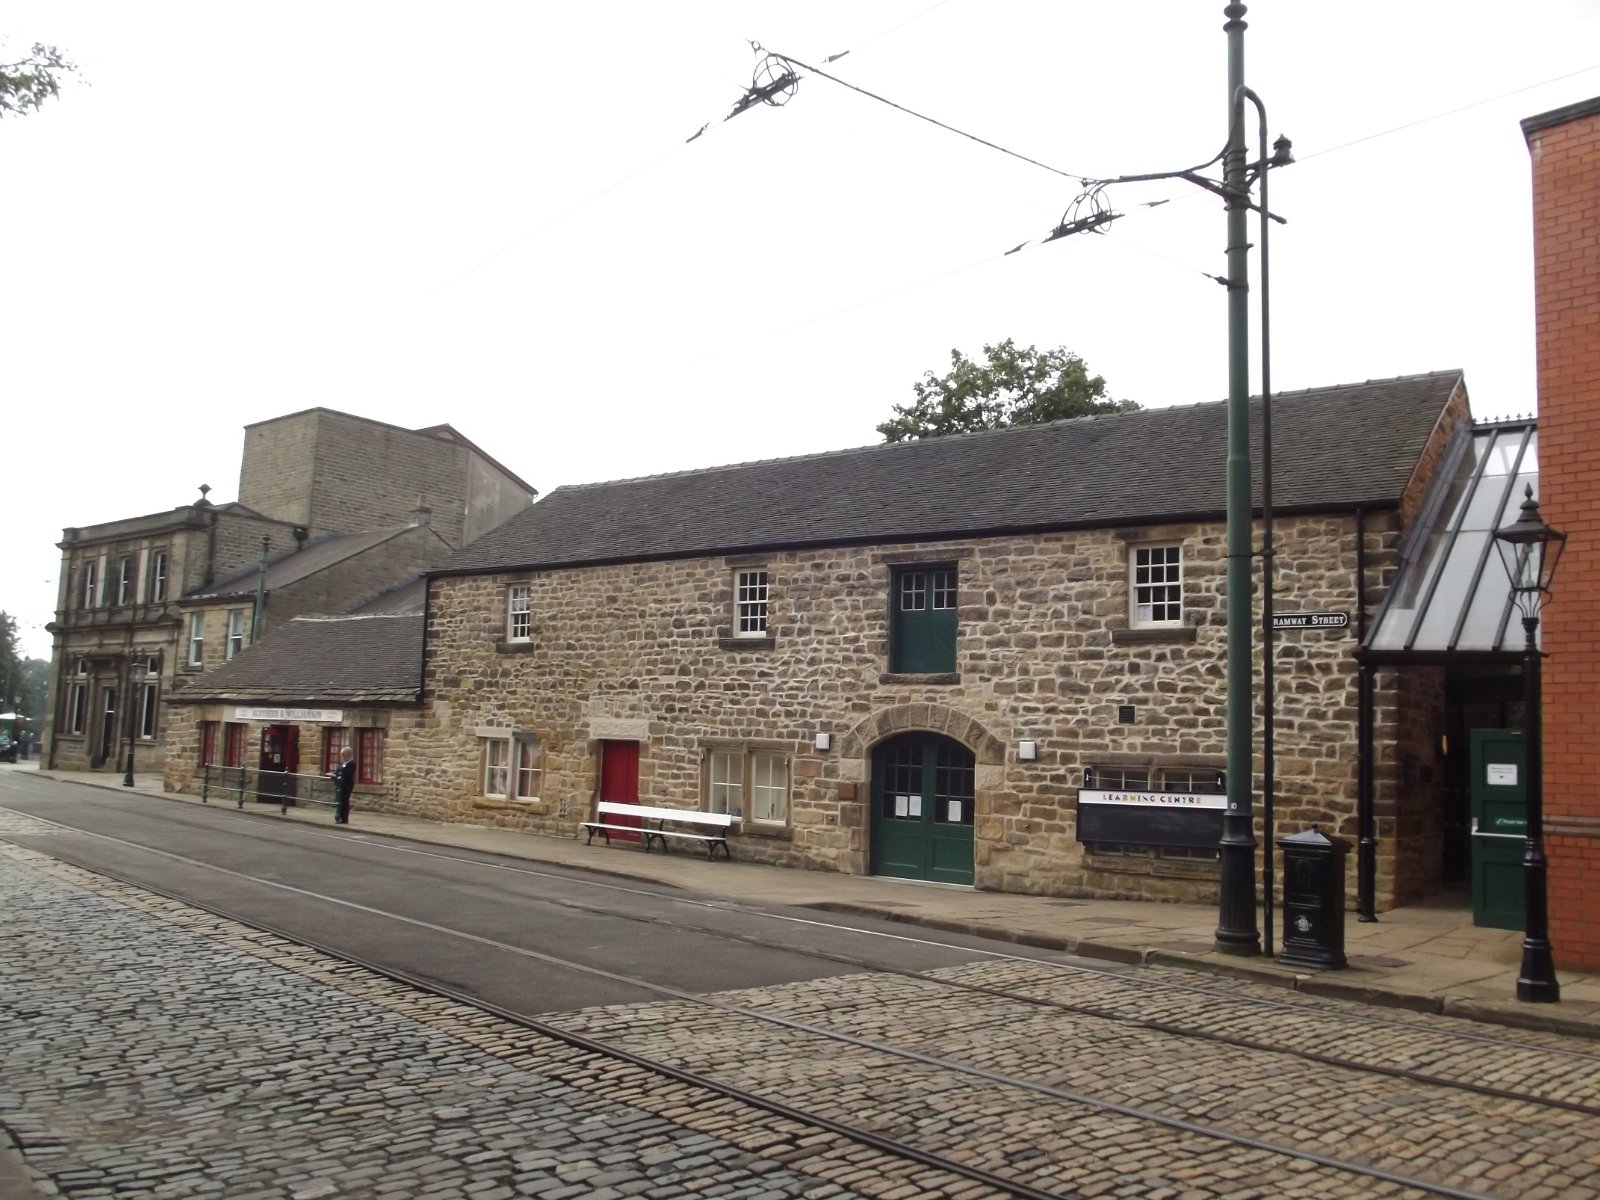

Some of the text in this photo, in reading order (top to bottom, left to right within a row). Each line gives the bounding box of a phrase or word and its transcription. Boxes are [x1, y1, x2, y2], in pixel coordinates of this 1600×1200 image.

[1273, 615, 1344, 626] RAMWAY STREET
[1103, 793, 1201, 804] LEARNING CENTRE
